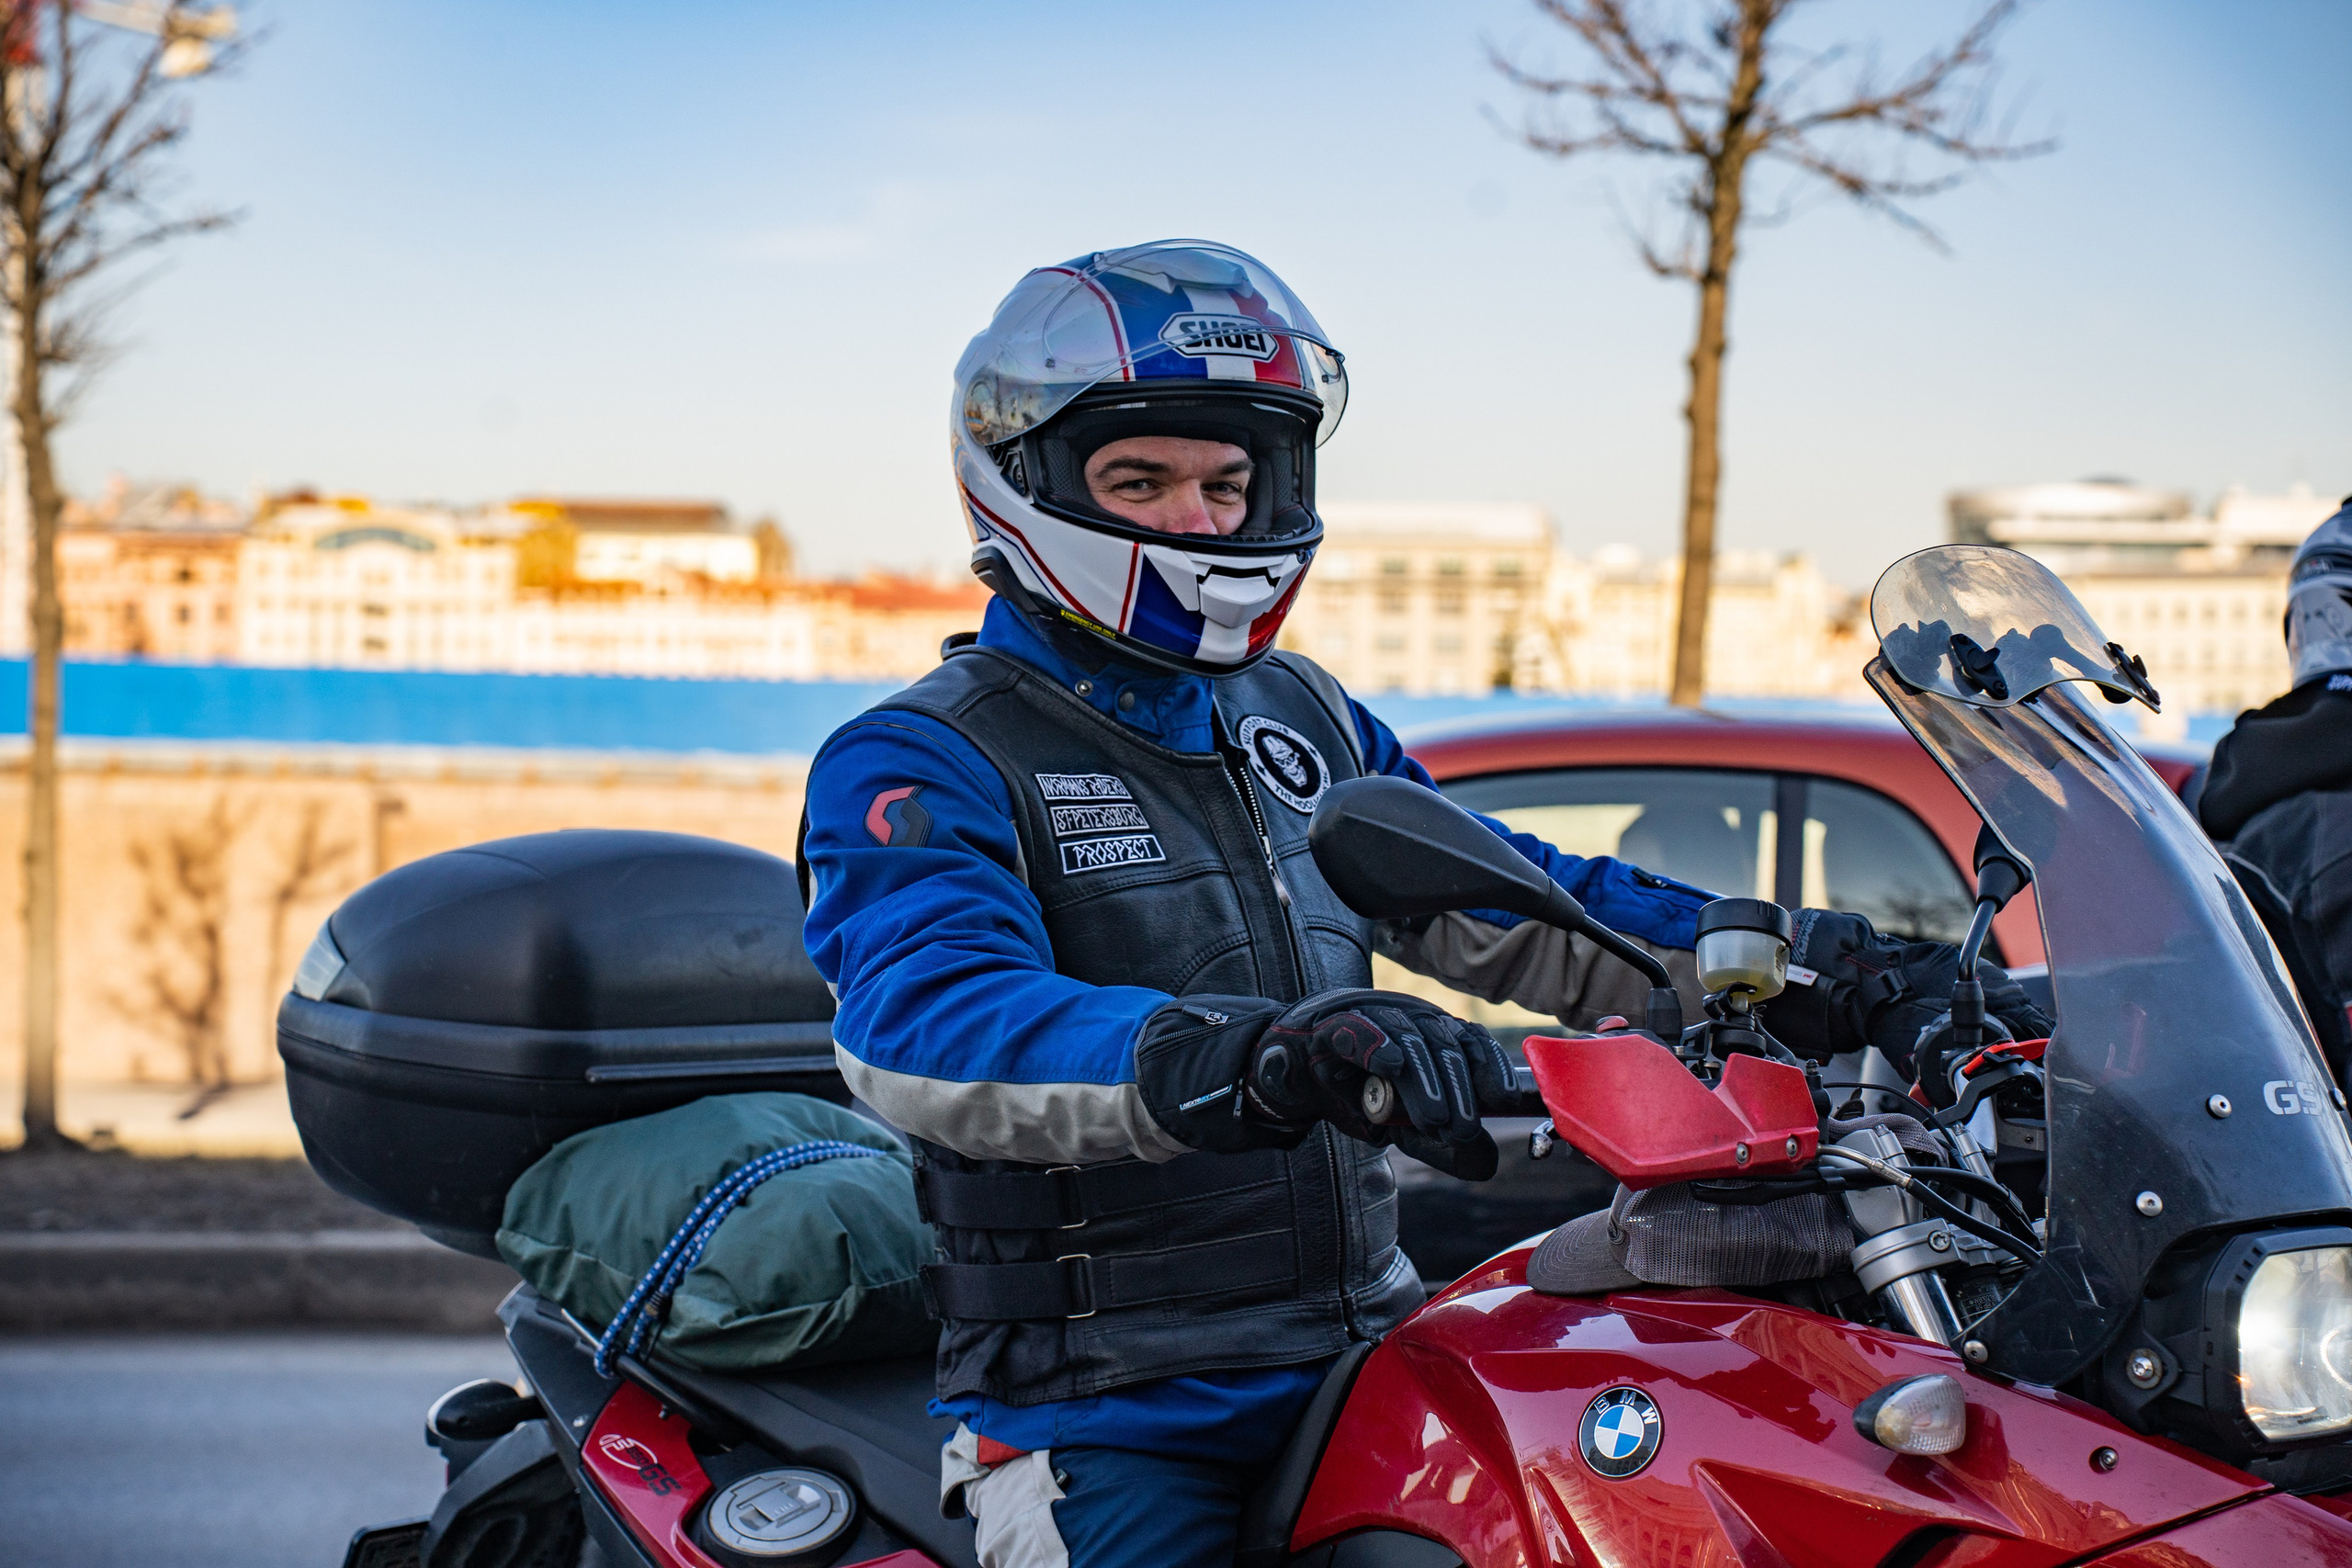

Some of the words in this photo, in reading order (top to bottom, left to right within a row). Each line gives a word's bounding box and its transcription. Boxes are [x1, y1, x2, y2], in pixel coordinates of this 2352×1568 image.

[1179, 321, 1267, 353] SHOEI
[1242, 717, 1261, 746] SUPPORT
[1263, 720, 1289, 735] CLUB
[1041, 777, 1091, 796] NORMANS
[1275, 784, 1293, 803] THE
[1073, 838, 1151, 868] PROSPECT
[2263, 1080, 2324, 1116] GS
[1594, 1390, 1657, 1425] BMW
